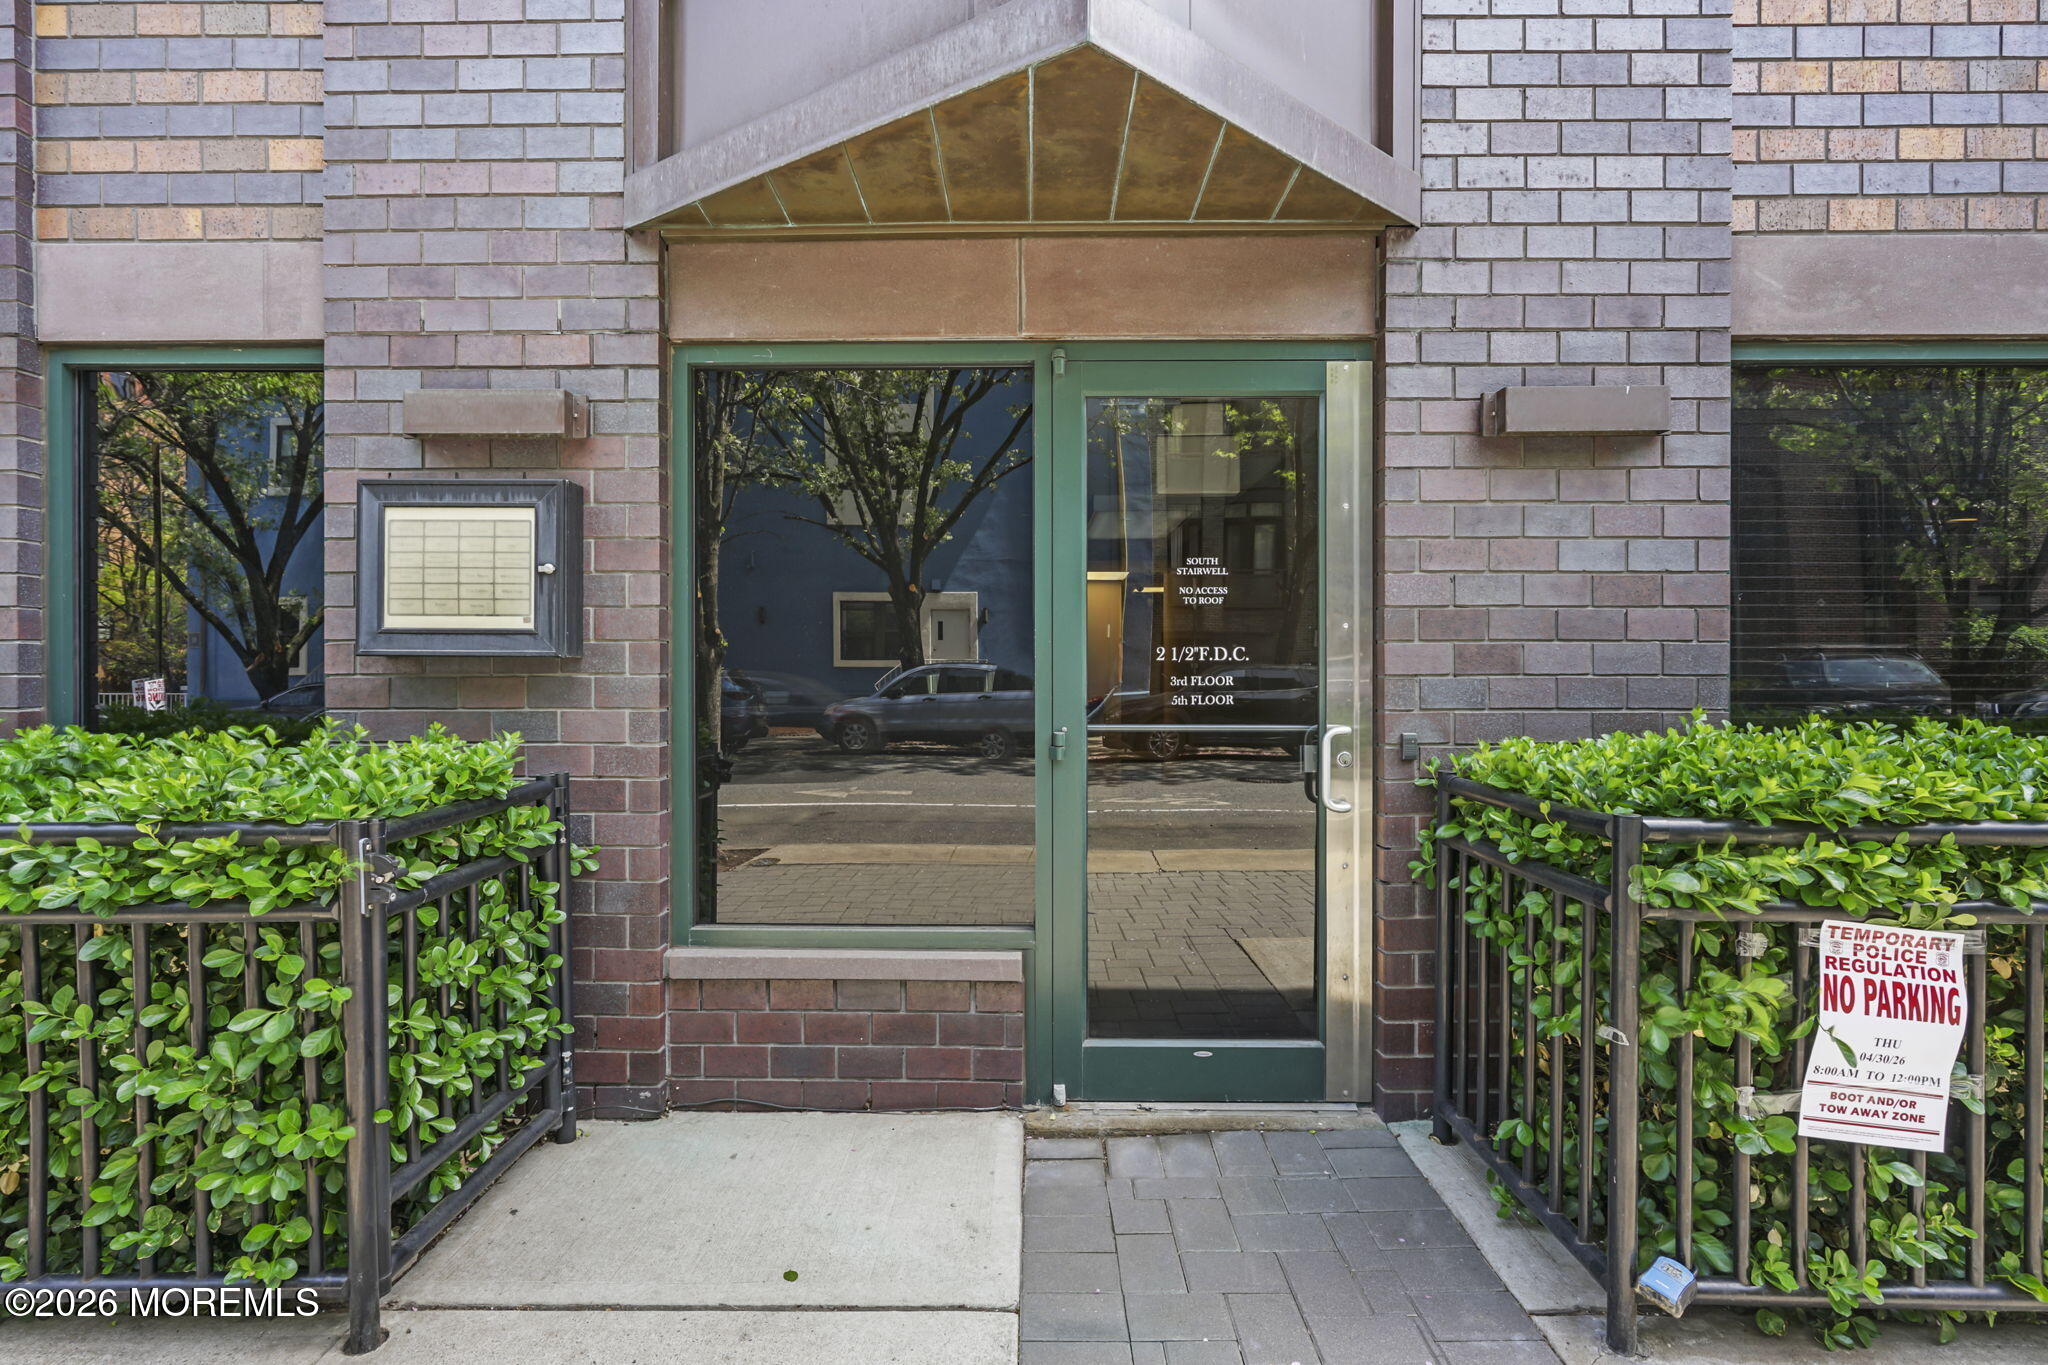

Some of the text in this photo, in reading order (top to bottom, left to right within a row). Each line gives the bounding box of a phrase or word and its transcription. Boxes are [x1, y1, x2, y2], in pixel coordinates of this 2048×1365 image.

[1186, 557, 1219, 566] SOUTH
[1176, 567, 1229, 576] STAIRWELL
[1179, 586, 1228, 595] NO ACCESS
[1183, 596, 1225, 605] TO ROOF
[1156, 646, 1166, 661] 2
[1170, 675, 1235, 686] 3rd FLOOR
[1171, 694, 1235, 705] 5th FLOOR
[1827, 925, 1956, 952] TEMPORARY
[1853, 943, 1928, 965] POLICE
[1824, 955, 1957, 984] REGULATION
[1823, 973, 1962, 1026] NO PARKING
[1874, 1037, 1903, 1050] THU
[1859, 1051, 1906, 1066] 04/30/26
[1812, 1065, 1942, 1088] 8:00AM TO 12:00PM
[1830, 1091, 1918, 1109] BOOT AND/OR
[1819, 1103, 1926, 1124] TOW AWAY ZONE
